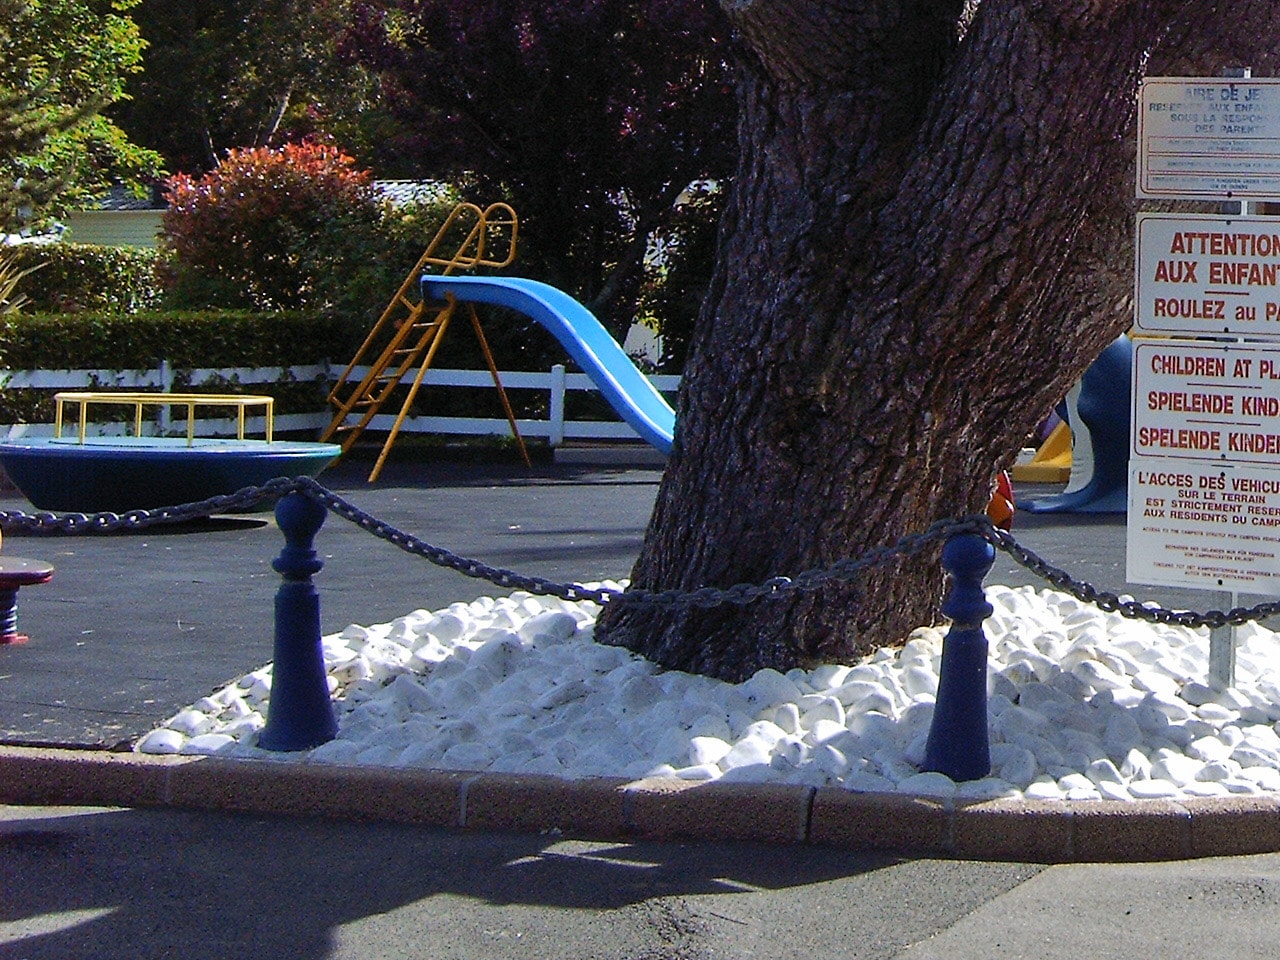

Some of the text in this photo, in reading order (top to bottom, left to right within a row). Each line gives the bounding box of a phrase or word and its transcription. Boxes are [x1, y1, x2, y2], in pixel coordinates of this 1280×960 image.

[1154, 260, 1198, 283] AUX
[1154, 298, 1225, 319] ROULEZ
[1235, 305, 1256, 321] au
[1151, 354, 1225, 378] CHILDREN
[1233, 359, 1252, 379] AT
[1148, 391, 1234, 414] SPIELENDE
[1139, 427, 1220, 451] SPELENDE
[1138, 471, 1193, 487] L'ACCES
[1199, 475, 1225, 490] DES
[1146, 498, 1165, 507] EST
[1171, 500, 1243, 513] STRICTEMENT
[1178, 489, 1266, 504] SUR LE TERRAIN
[1143, 508, 1165, 518] AUX
[1170, 510, 1228, 524] RESIDENTS
[1232, 515, 1247, 525] DU
